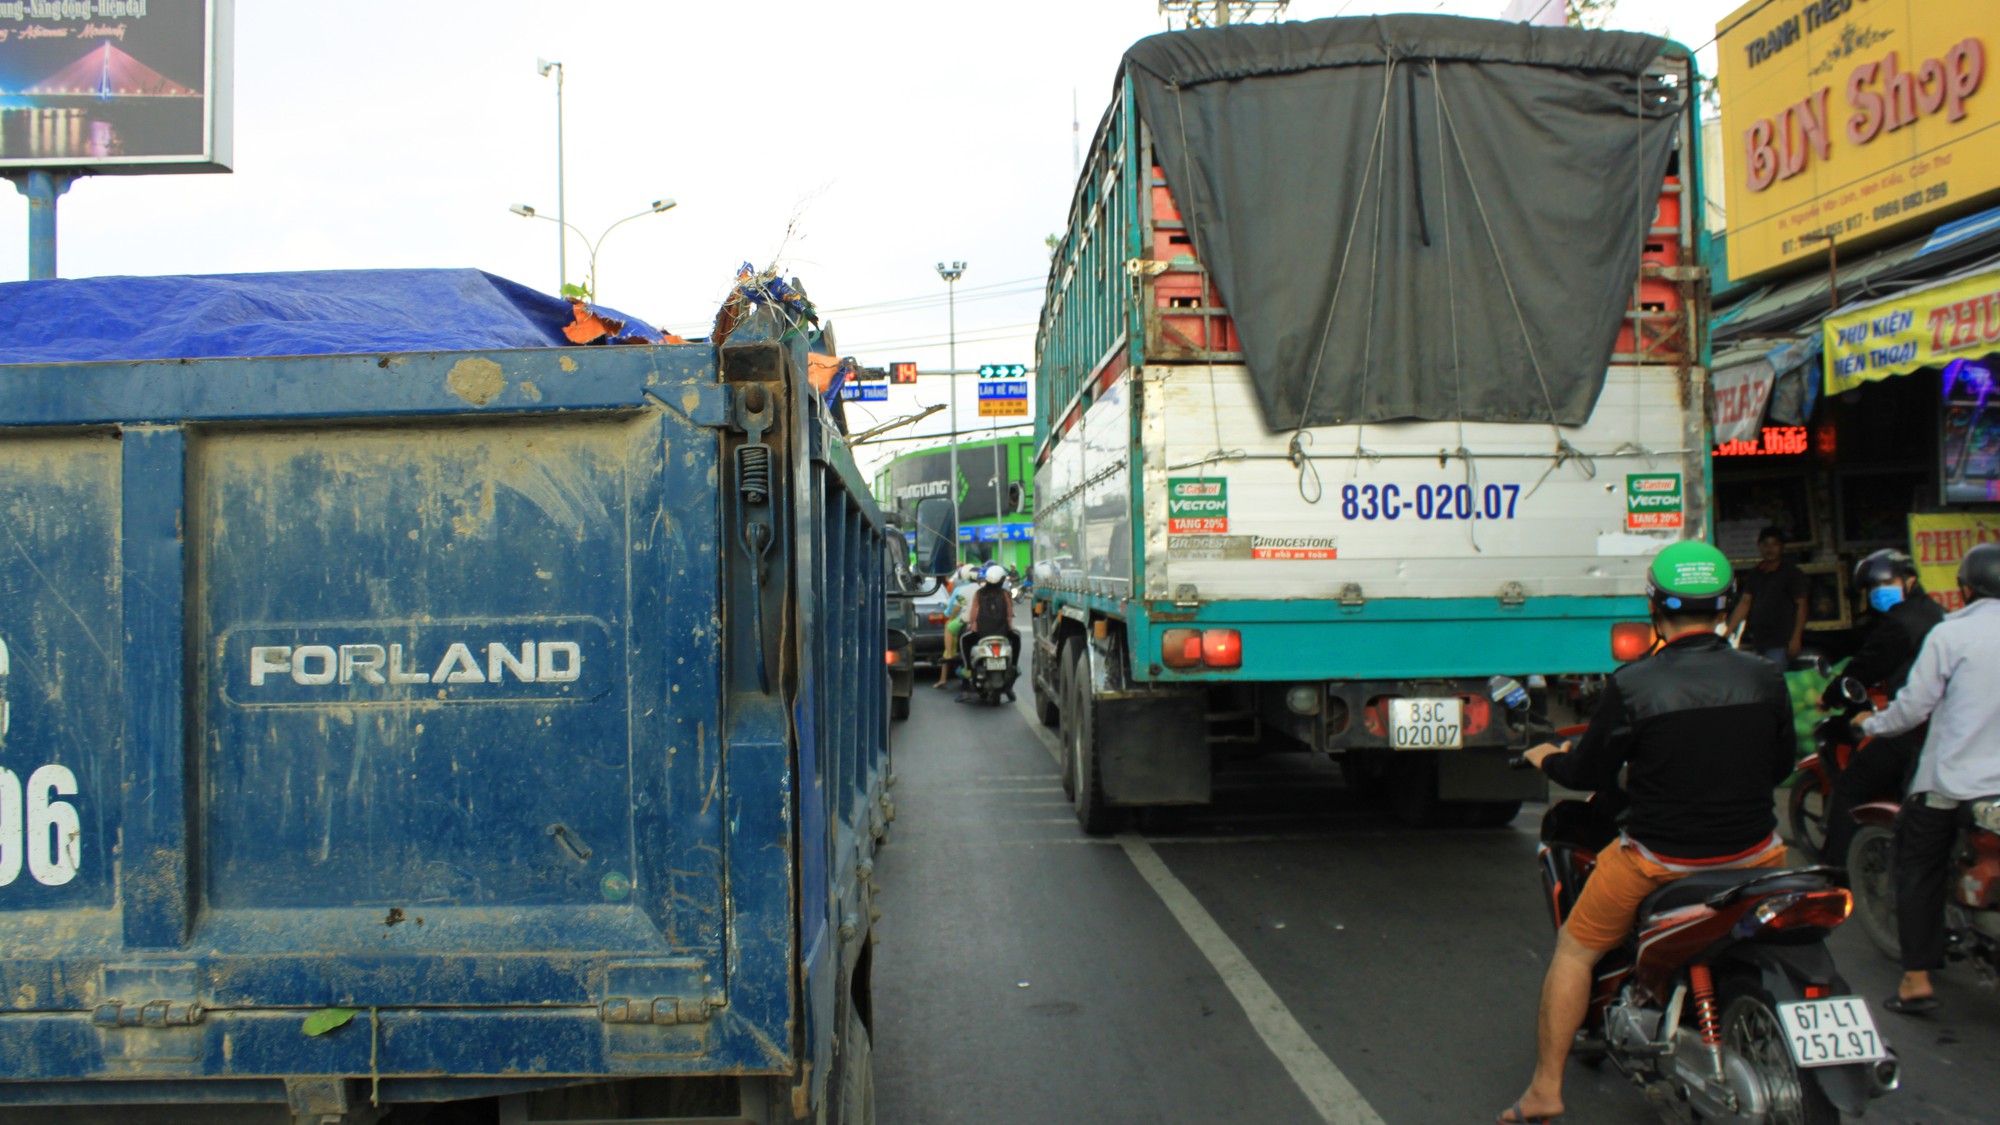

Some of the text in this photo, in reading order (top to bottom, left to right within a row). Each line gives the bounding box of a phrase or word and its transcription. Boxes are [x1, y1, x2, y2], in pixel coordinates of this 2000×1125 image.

[1744, 14, 1800, 69] TRANH
[1846, 37, 1986, 145] Shop
[1341, 484, 1521, 520] 83C-020.07
[1254, 536, 1335, 548] BRIDGESTONE
[249, 641, 581, 686] FORLAND
[1410, 702, 1445, 723] 83C
[1396, 724, 1459, 746] 020.07
[1795, 1030, 1876, 1061] 252.97
